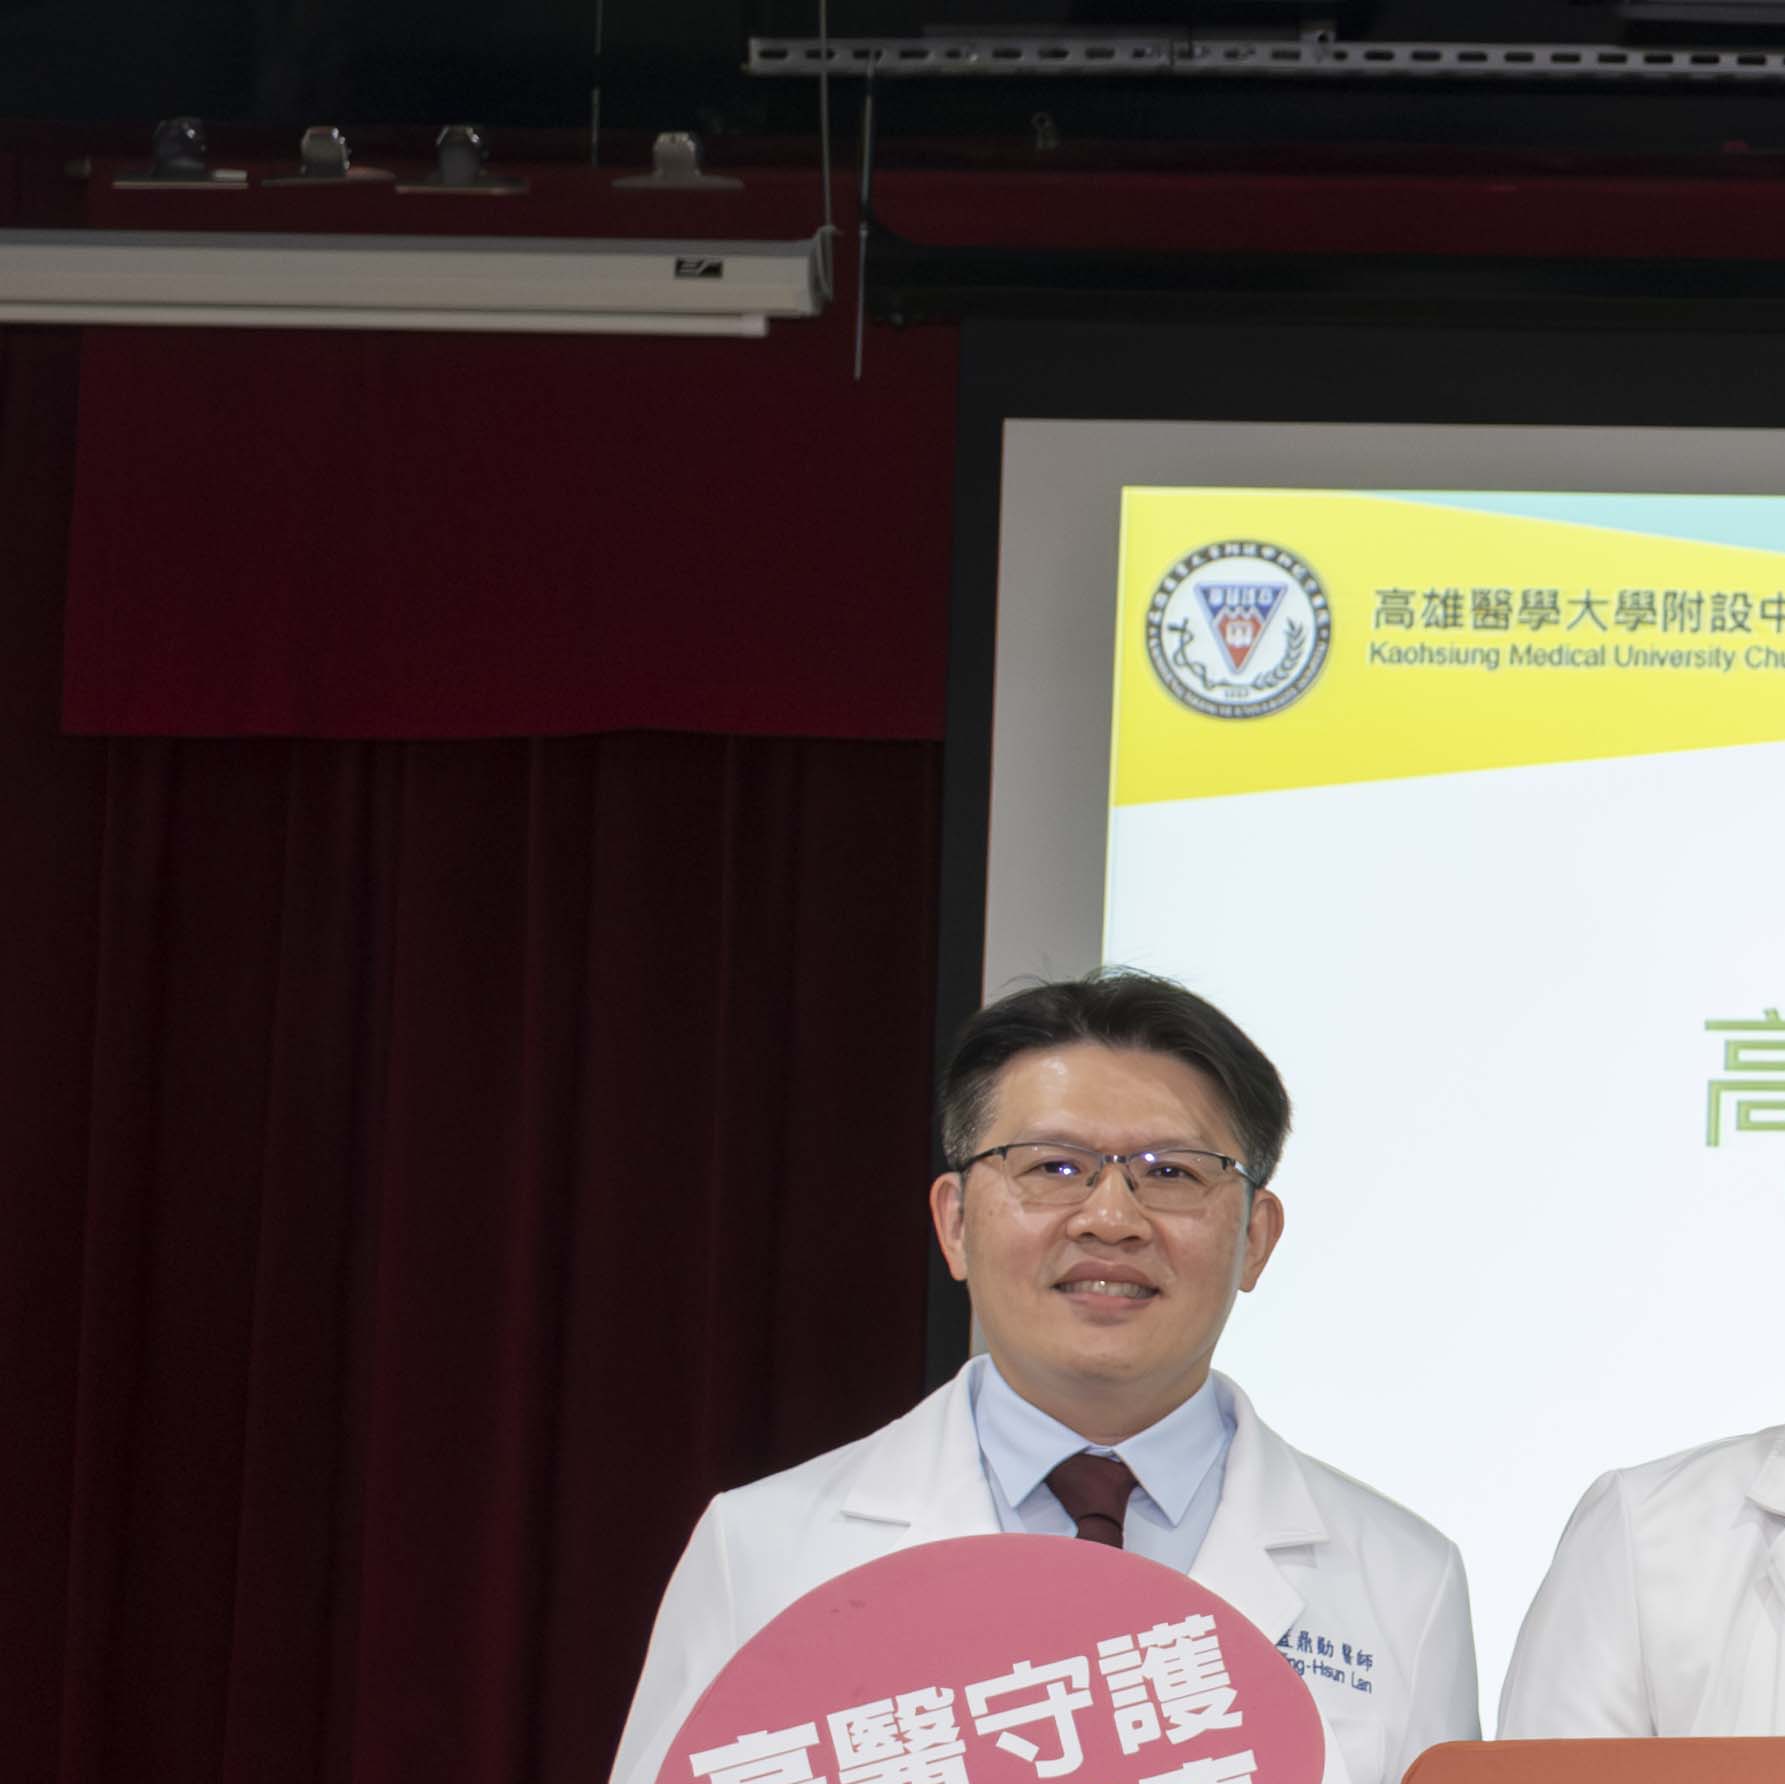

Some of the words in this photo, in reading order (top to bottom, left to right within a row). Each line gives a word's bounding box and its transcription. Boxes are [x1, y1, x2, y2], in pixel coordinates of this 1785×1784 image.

[1369, 642, 1501, 670] Kaohsiung
[1509, 643, 1606, 667] Medical
[1614, 644, 1736, 672] University
